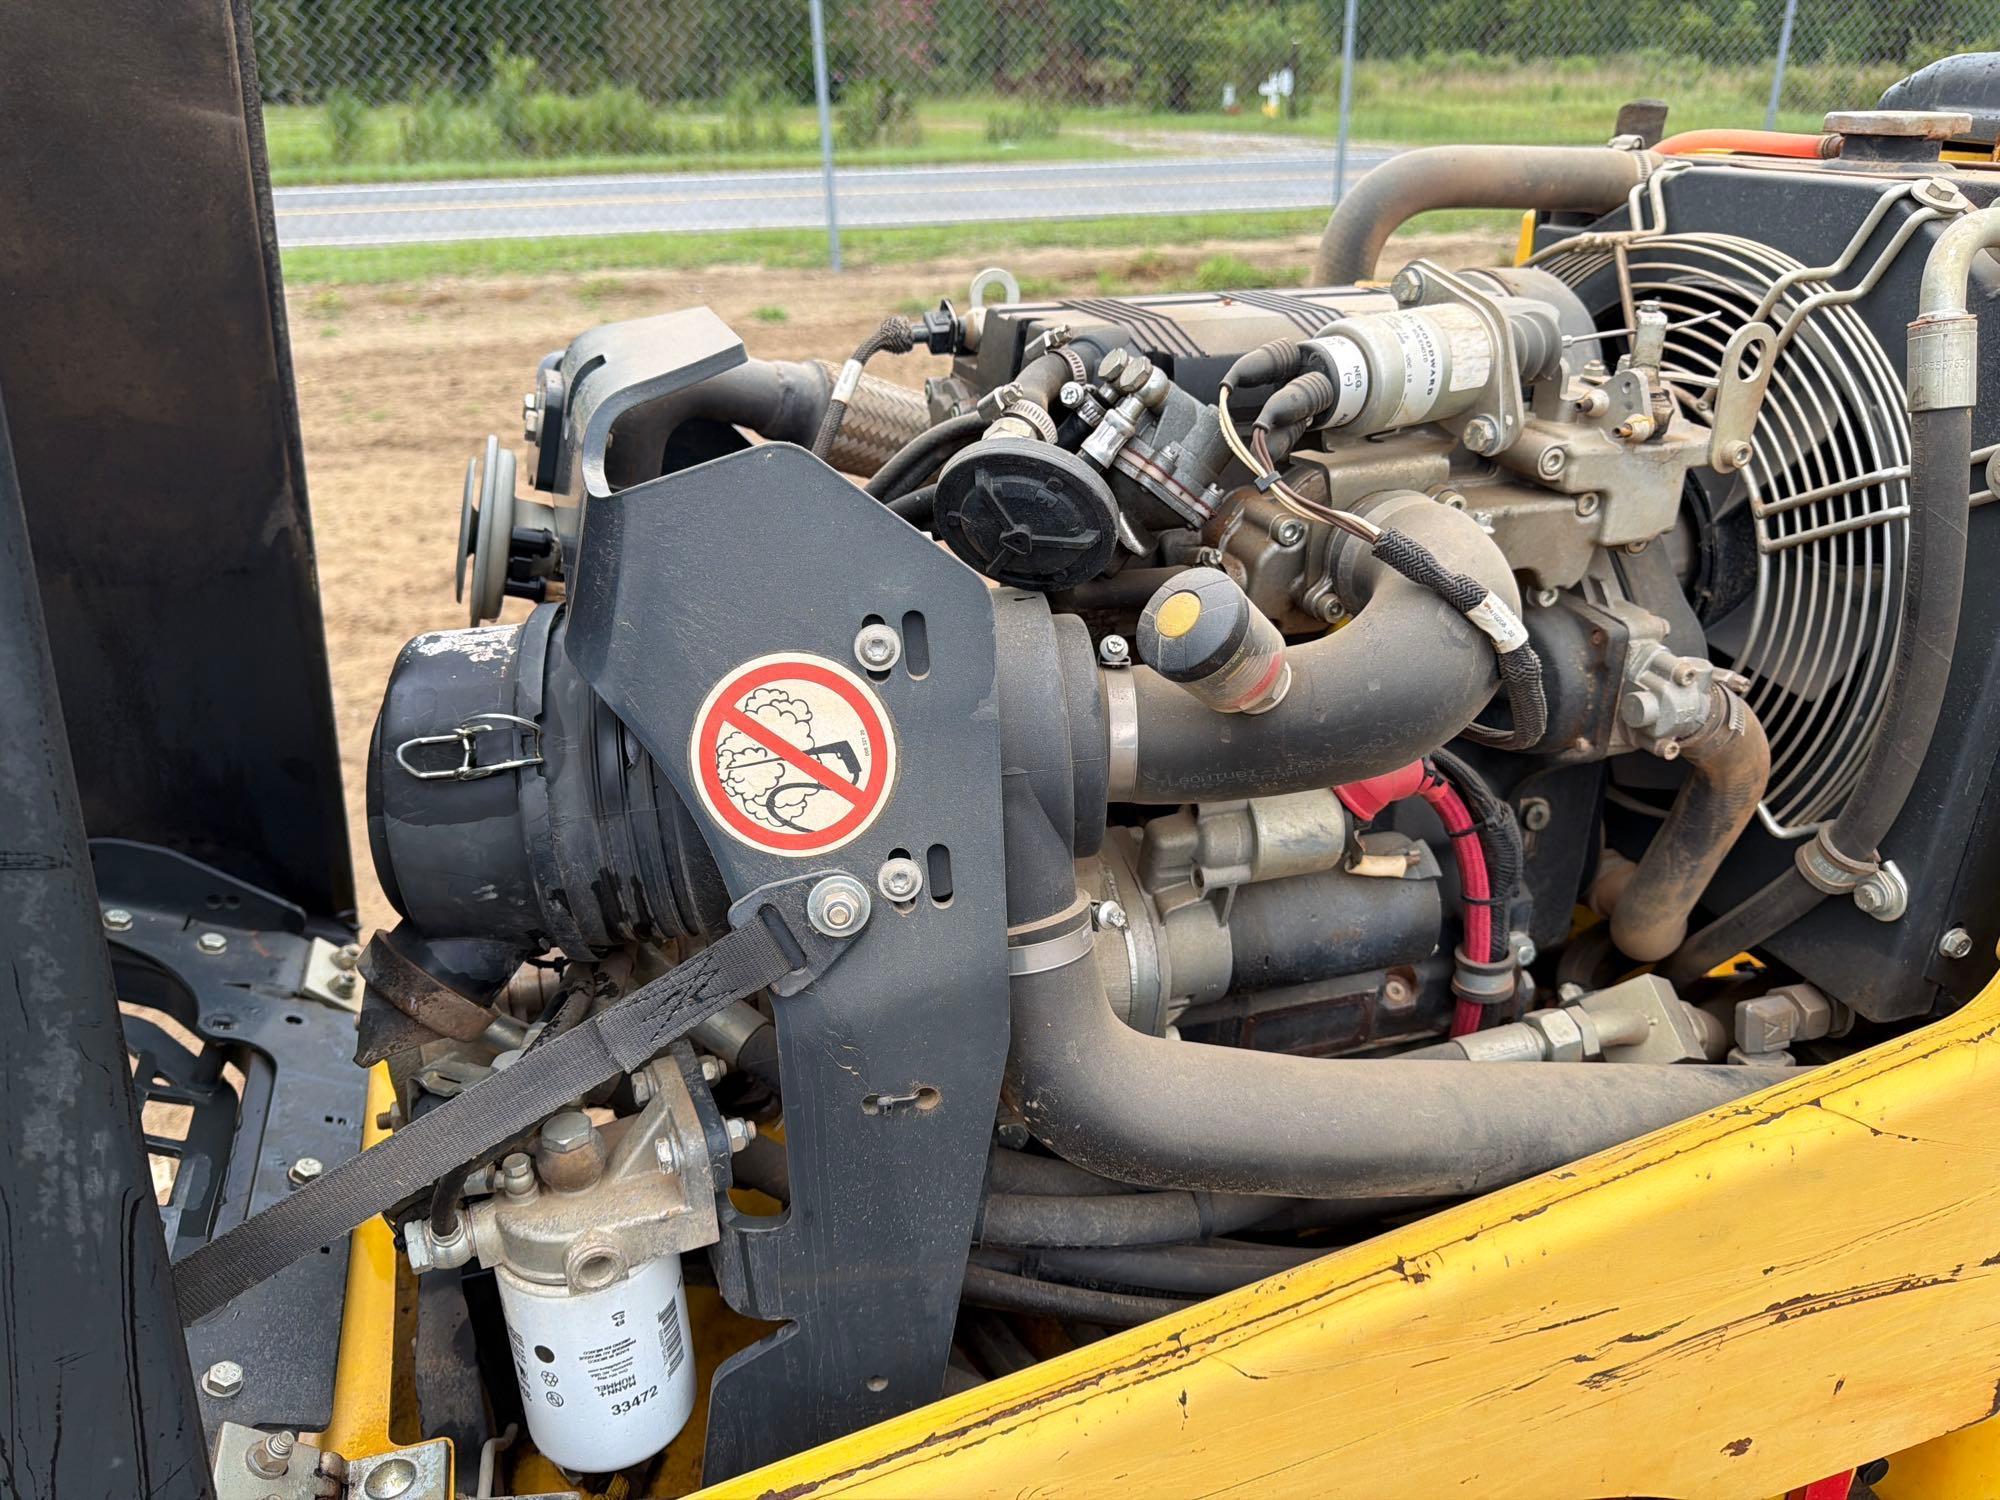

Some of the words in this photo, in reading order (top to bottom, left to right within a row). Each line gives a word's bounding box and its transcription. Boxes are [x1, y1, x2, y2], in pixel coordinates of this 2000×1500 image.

[1417, 323, 1437, 396] WOODWARD
[1353, 365, 1363, 392] NEG.
[594, 1373, 636, 1393] HUMMEL
[611, 1385, 659, 1416] 33472
